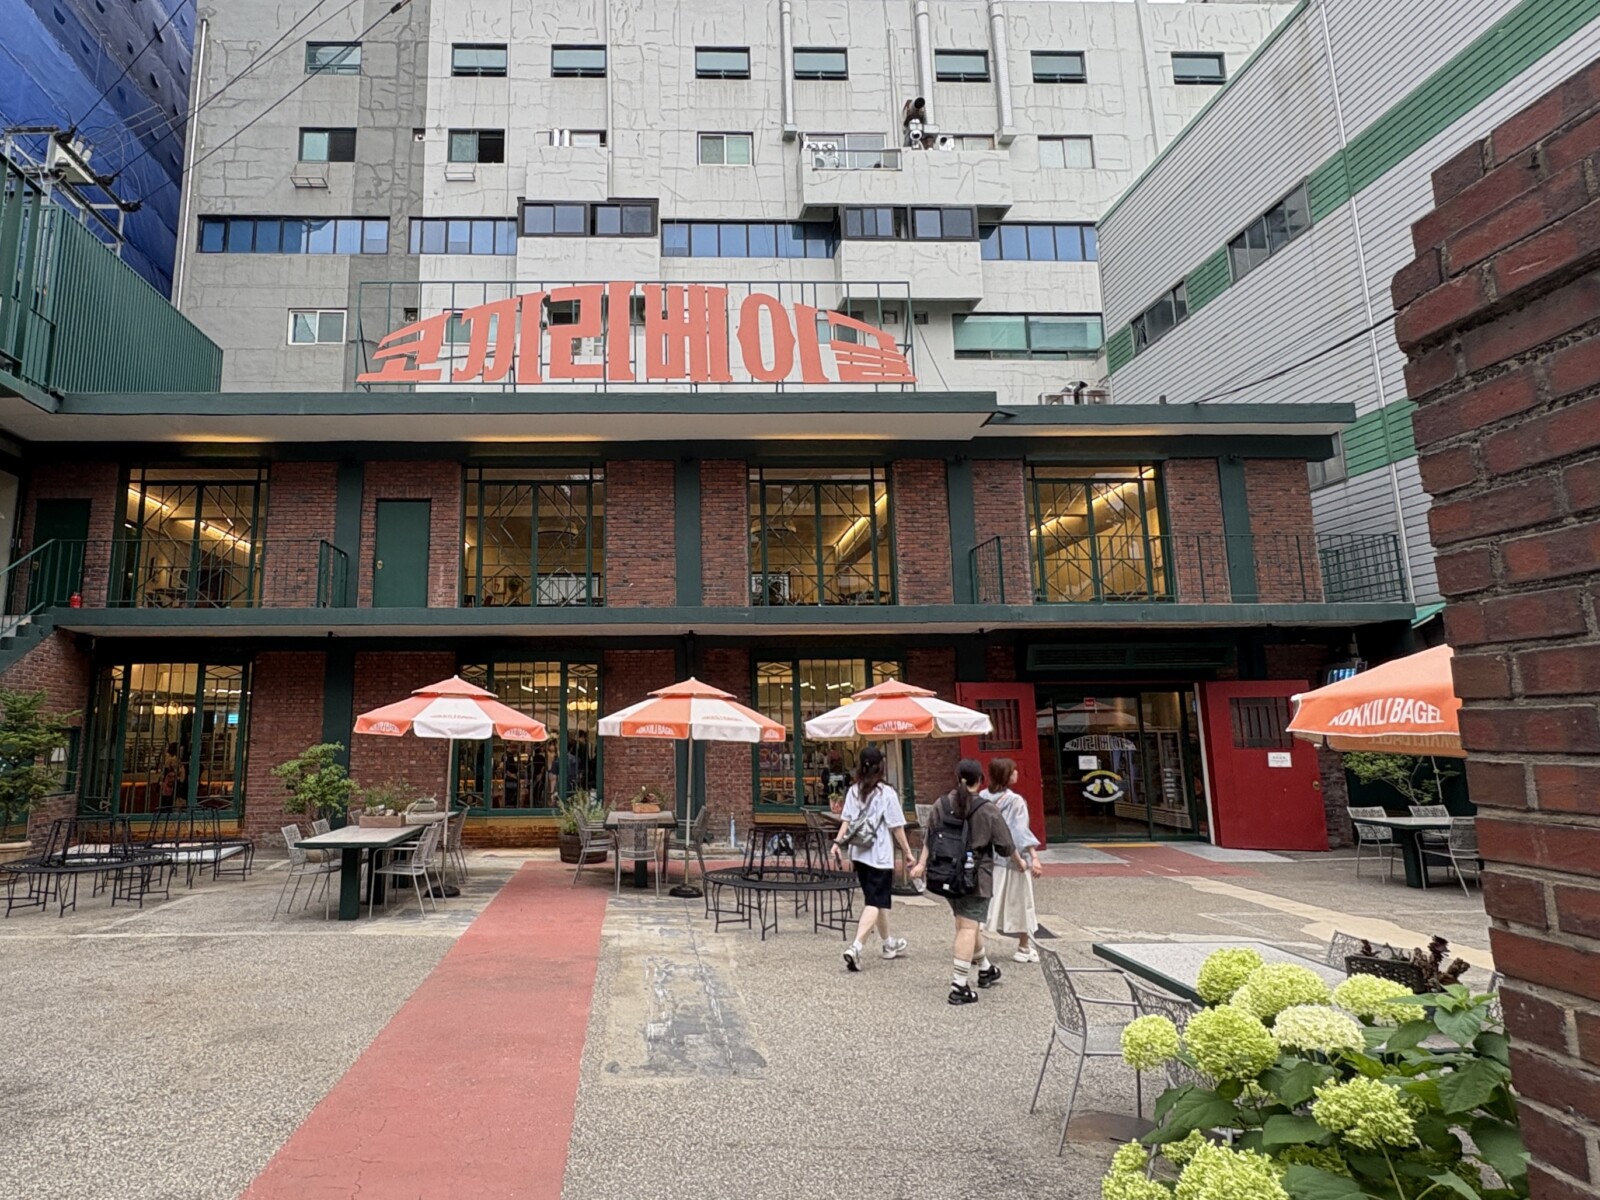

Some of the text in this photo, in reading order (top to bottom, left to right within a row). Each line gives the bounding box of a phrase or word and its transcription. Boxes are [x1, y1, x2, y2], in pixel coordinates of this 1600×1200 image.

[356, 281, 917, 383] 코끼리베이글
[1328, 697, 1445, 727] KOKKILI BAGEL
